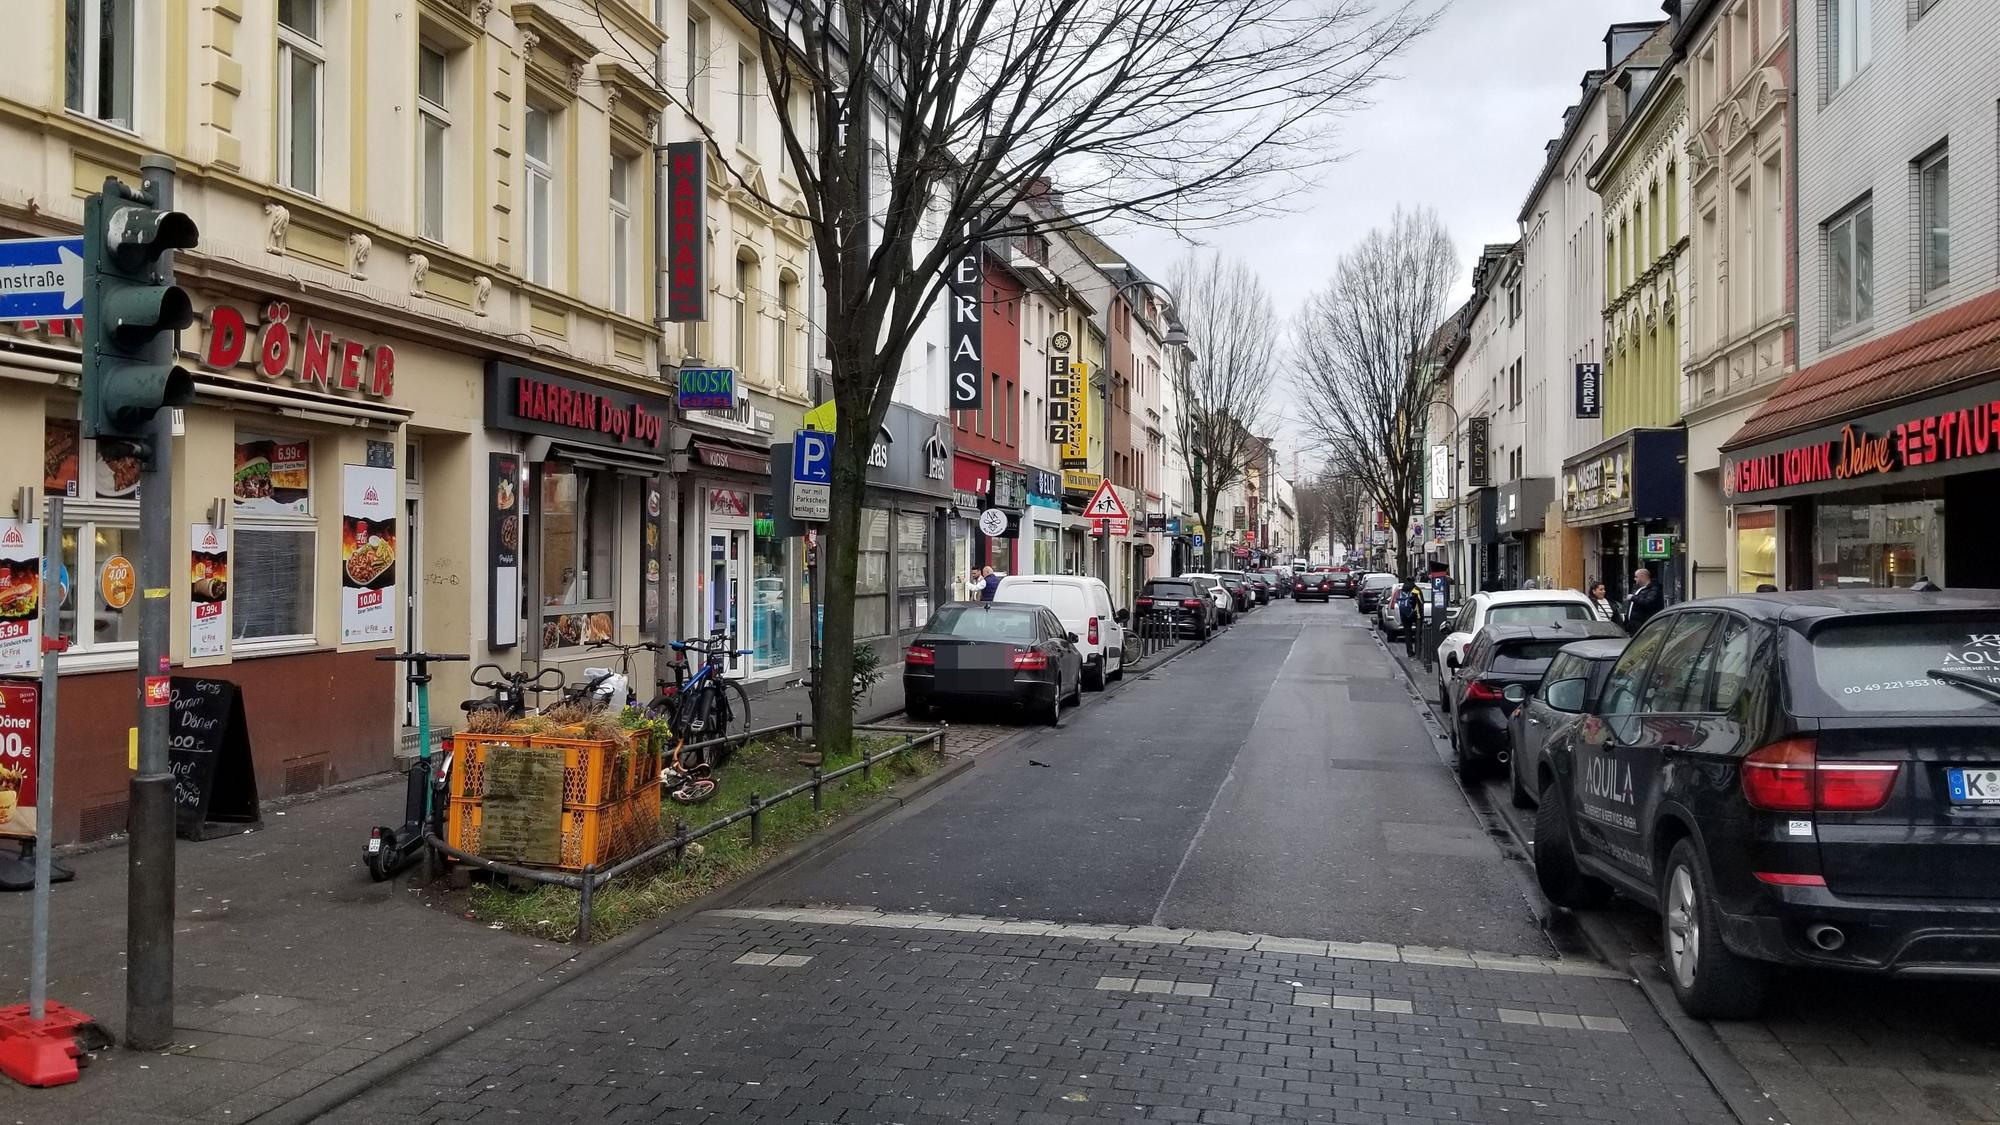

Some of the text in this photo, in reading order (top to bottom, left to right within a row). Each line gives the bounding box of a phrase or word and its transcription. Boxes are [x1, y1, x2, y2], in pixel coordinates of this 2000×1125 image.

[673, 153, 696, 288] HARRAN
[0, 270, 65, 289] nstraße
[204, 300, 396, 399] DÖNER
[681, 371, 731, 393] KIOSK
[1583, 364, 1595, 413] HASRET
[518, 375, 597, 430] HARRAN
[601, 395, 631, 443] Doy
[635, 403, 663, 448] Doy
[1055, 359, 1065, 440] ELIZ
[709, 451, 729, 467] KIOSK
[803, 437, 826, 476] P
[867, 443, 888, 468] ras
[1783, 441, 1832, 486] KONAK
[1836, 423, 1895, 481] Deluxe
[1577, 460, 1602, 492] HASRET
[797, 495, 827, 504] Parkschein
[1844, 678, 1946, 694] 00 49 221 953 16
[1585, 756, 1634, 806] AQUILA
[1954, 787, 1962, 795] D
[1966, 773, 1985, 797] K
